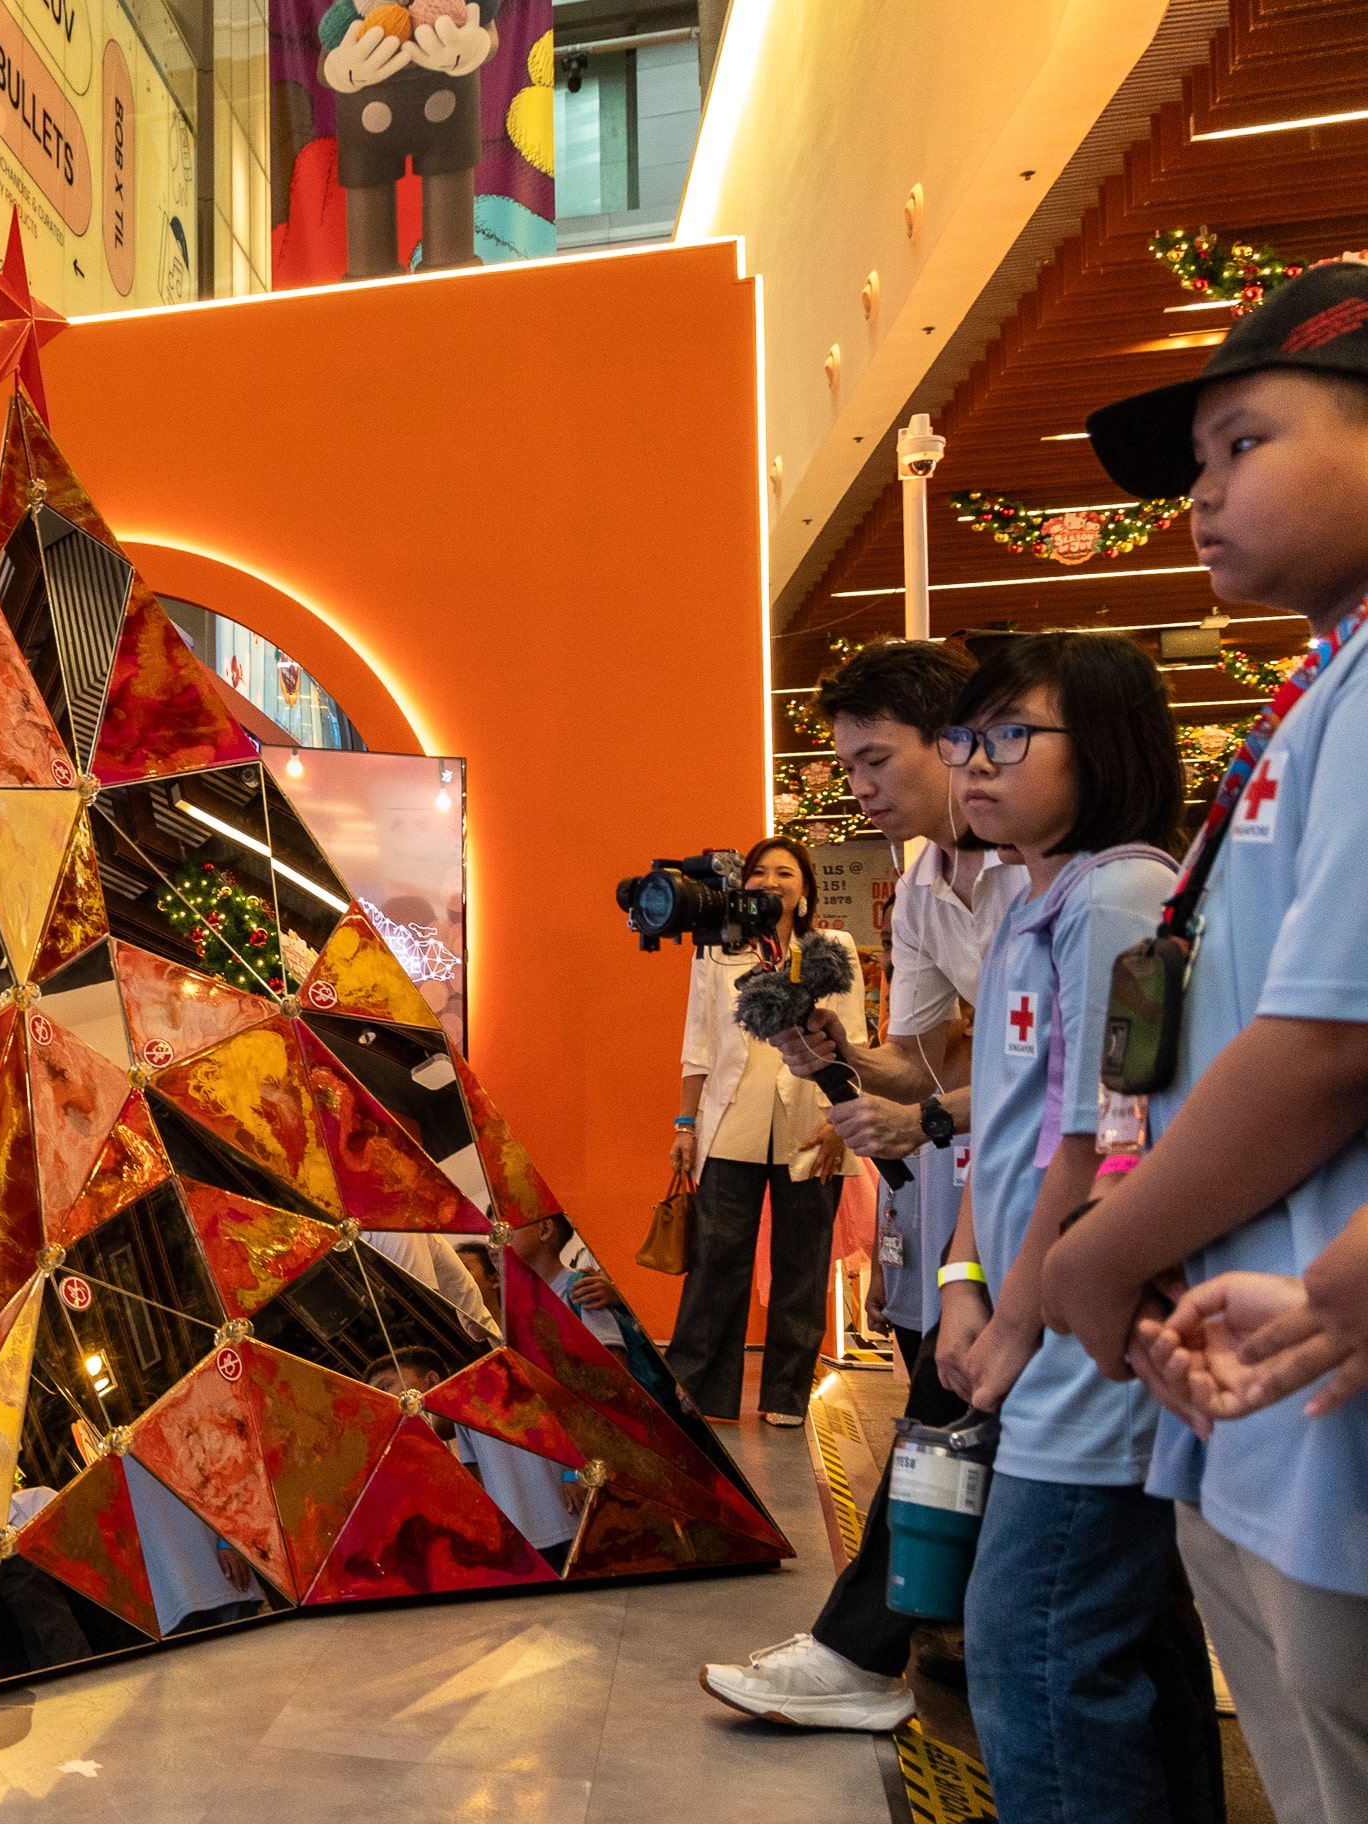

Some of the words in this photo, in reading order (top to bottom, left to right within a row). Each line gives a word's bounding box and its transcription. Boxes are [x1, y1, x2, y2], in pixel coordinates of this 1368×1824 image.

[114, 96, 124, 171] BOB
[822, 864, 844, 876] us
[849, 861, 864, 875] @
[923, 1741, 962, 1781] STEP
